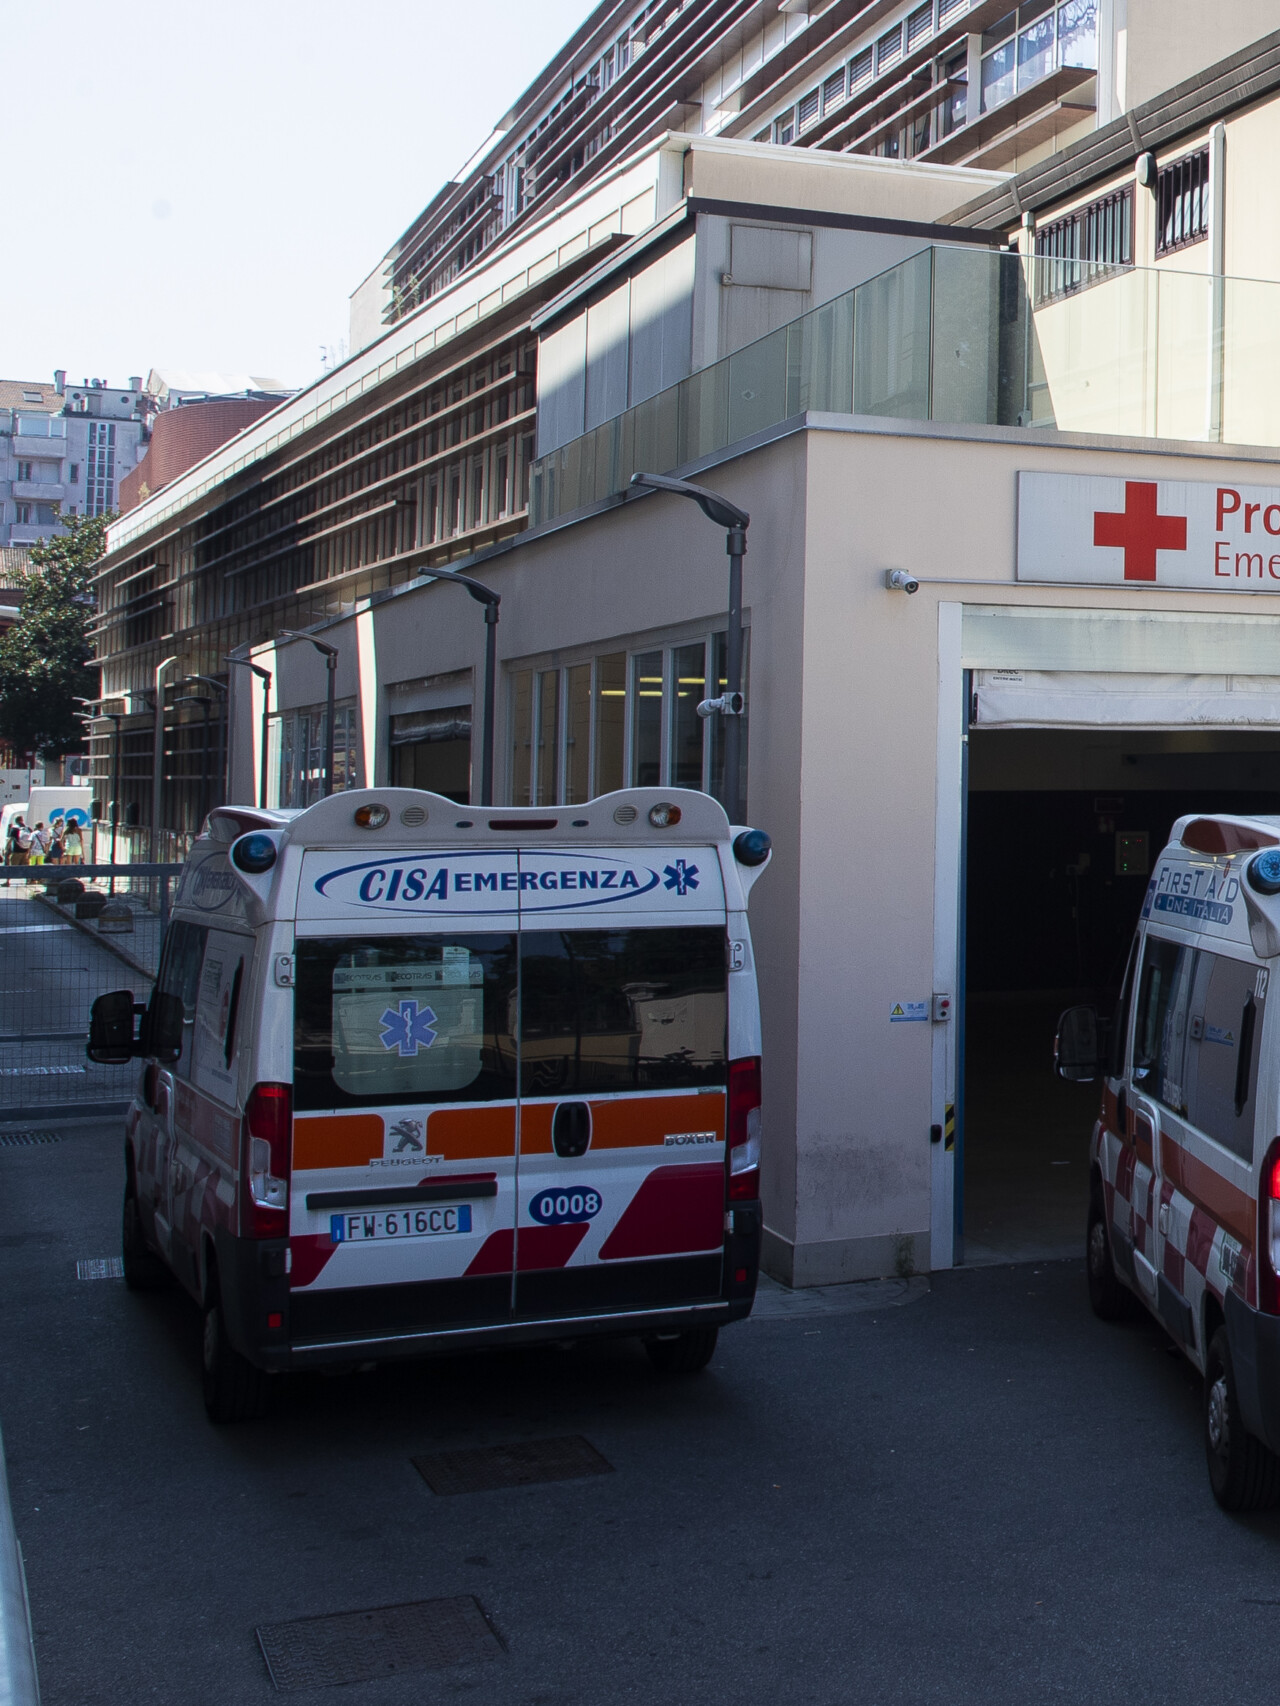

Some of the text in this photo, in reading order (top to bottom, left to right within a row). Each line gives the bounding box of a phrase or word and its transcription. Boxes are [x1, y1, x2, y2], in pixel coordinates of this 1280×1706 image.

[358, 868, 640, 902] CISA EMERGENZA
[1158, 867, 1204, 896] FIRST
[1166, 896, 1190, 914] ONE
[1192, 902, 1229, 924] ITALIA
[664, 1133, 716, 1146] BOXER
[370, 1157, 443, 1168] PEUGEOT
[540, 1194, 598, 1218] 0008
